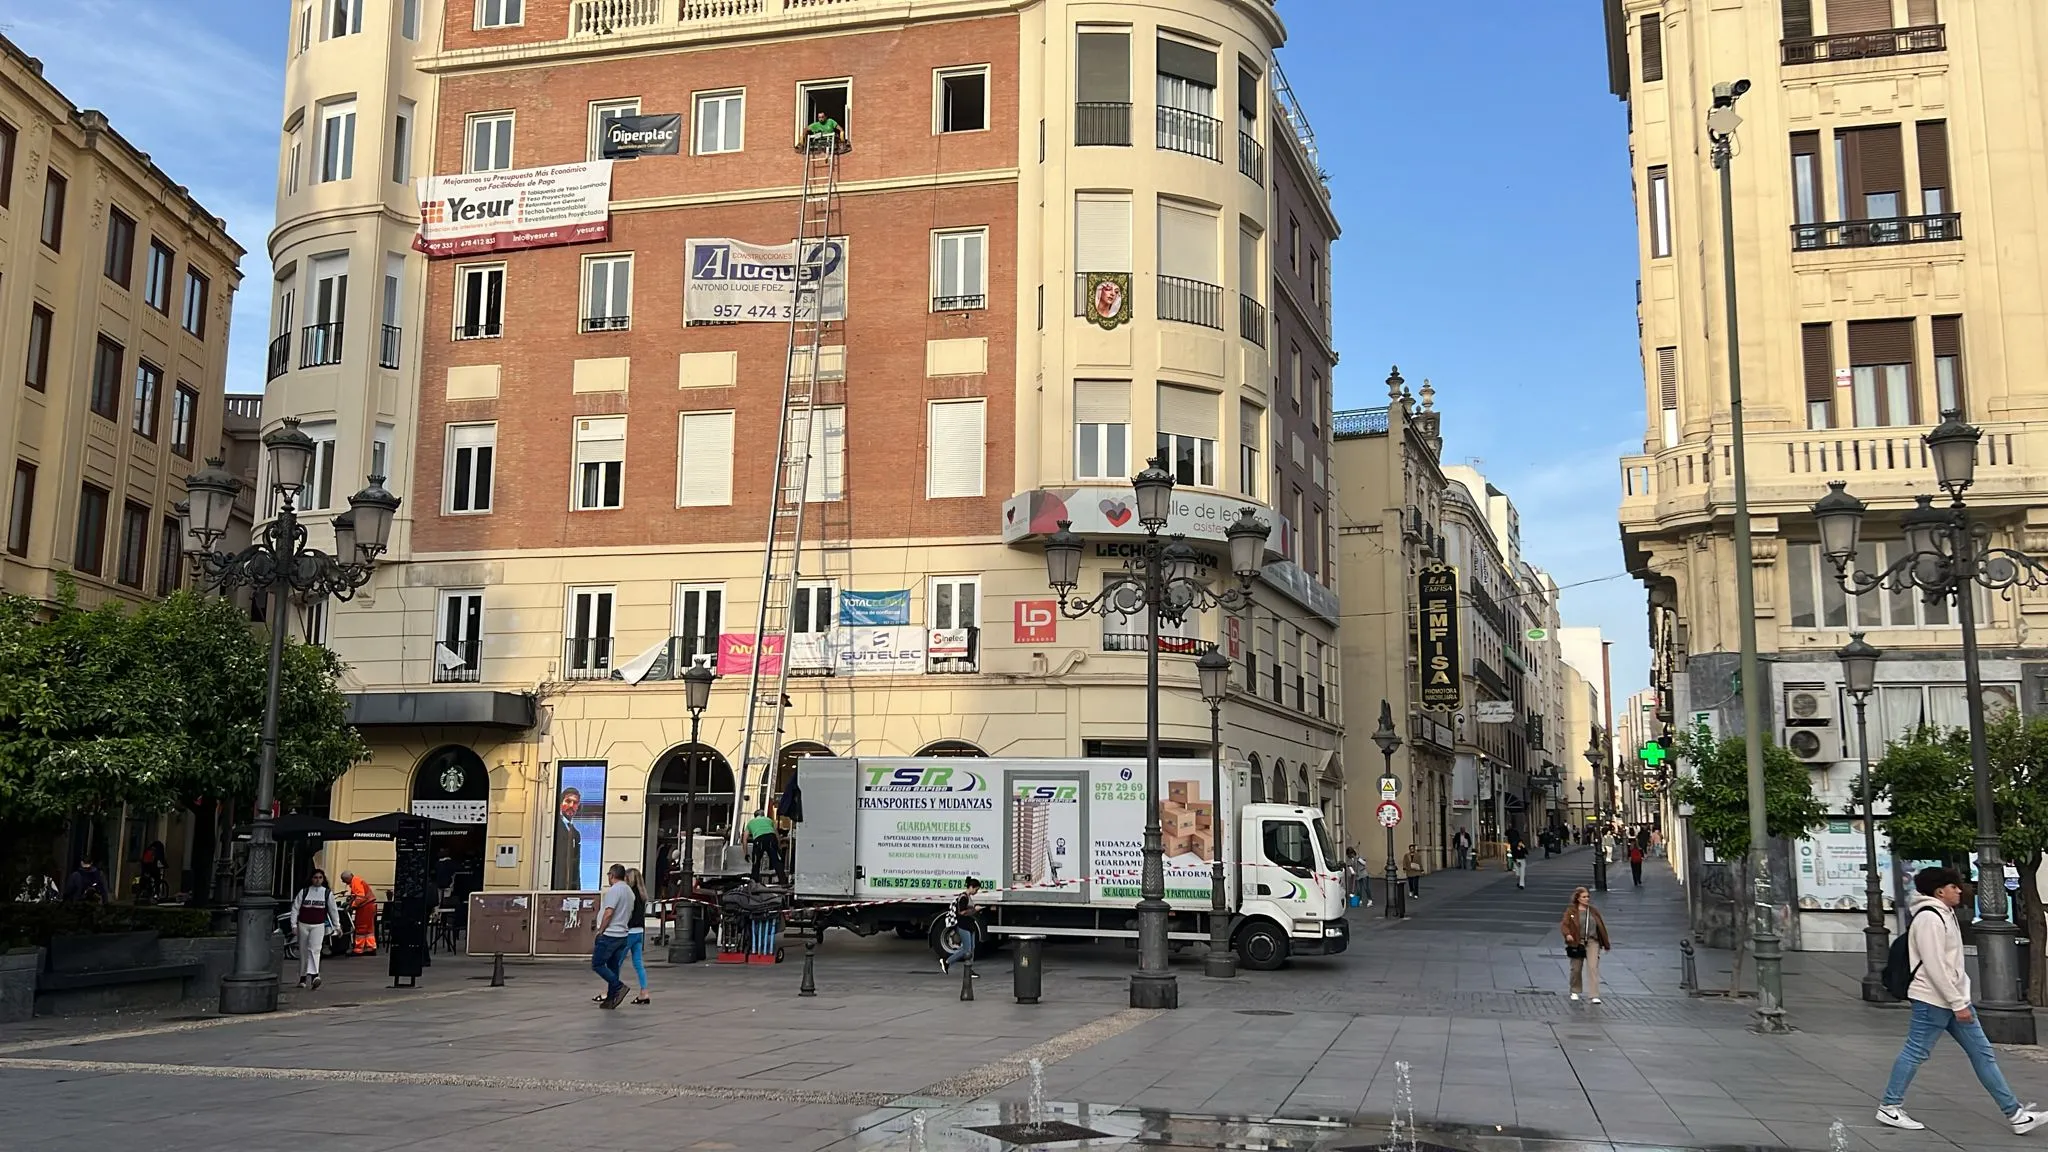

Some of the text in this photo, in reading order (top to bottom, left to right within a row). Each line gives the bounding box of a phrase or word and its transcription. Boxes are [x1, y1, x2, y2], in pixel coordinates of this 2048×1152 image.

[613, 129, 672, 144] Diperplac
[443, 176, 482, 185] Mejoramos
[492, 172, 533, 183] Presupuesto
[535, 169, 549, 177] Más
[550, 166, 587, 175] Económico
[488, 179, 525, 190] Facilidades
[527, 179, 537, 187] de
[538, 178, 555, 187] Pago
[447, 196, 514, 222] Yesur
[577, 226, 604, 235] yesur.es
[732, 252, 793, 260] CONSTRUCCIONES
[730, 284, 759, 292] LUQUE
[714, 305, 742, 317] 957
[747, 305, 777, 318] 474
[1168, 500, 1189, 516] lle
[1195, 503, 1215, 519] de
[1022, 603, 1052, 636] LP
[934, 634, 964, 644] Sinelec
[1429, 600, 1450, 684] EMFISA
[866, 768, 954, 785] TSR
[1017, 787, 1077, 799] TSR
[1095, 783, 1143, 792] 957 29 69
[1095, 792, 1114, 801] 678
[1117, 792, 1136, 801] 425
[859, 797, 992, 809] TRANSPORTES Y MUDANZAS
[897, 821, 971, 832] GUARDAMUEBLES
[873, 878, 893, 887] Telfs.
[895, 879, 908, 887] 957
[910, 879, 920, 888] 29
[921, 879, 931, 888] 69
[933, 880, 941, 888] 76
[949, 880, 961, 889] 678
[1171, 890, 1210, 898] PARTICULARES
